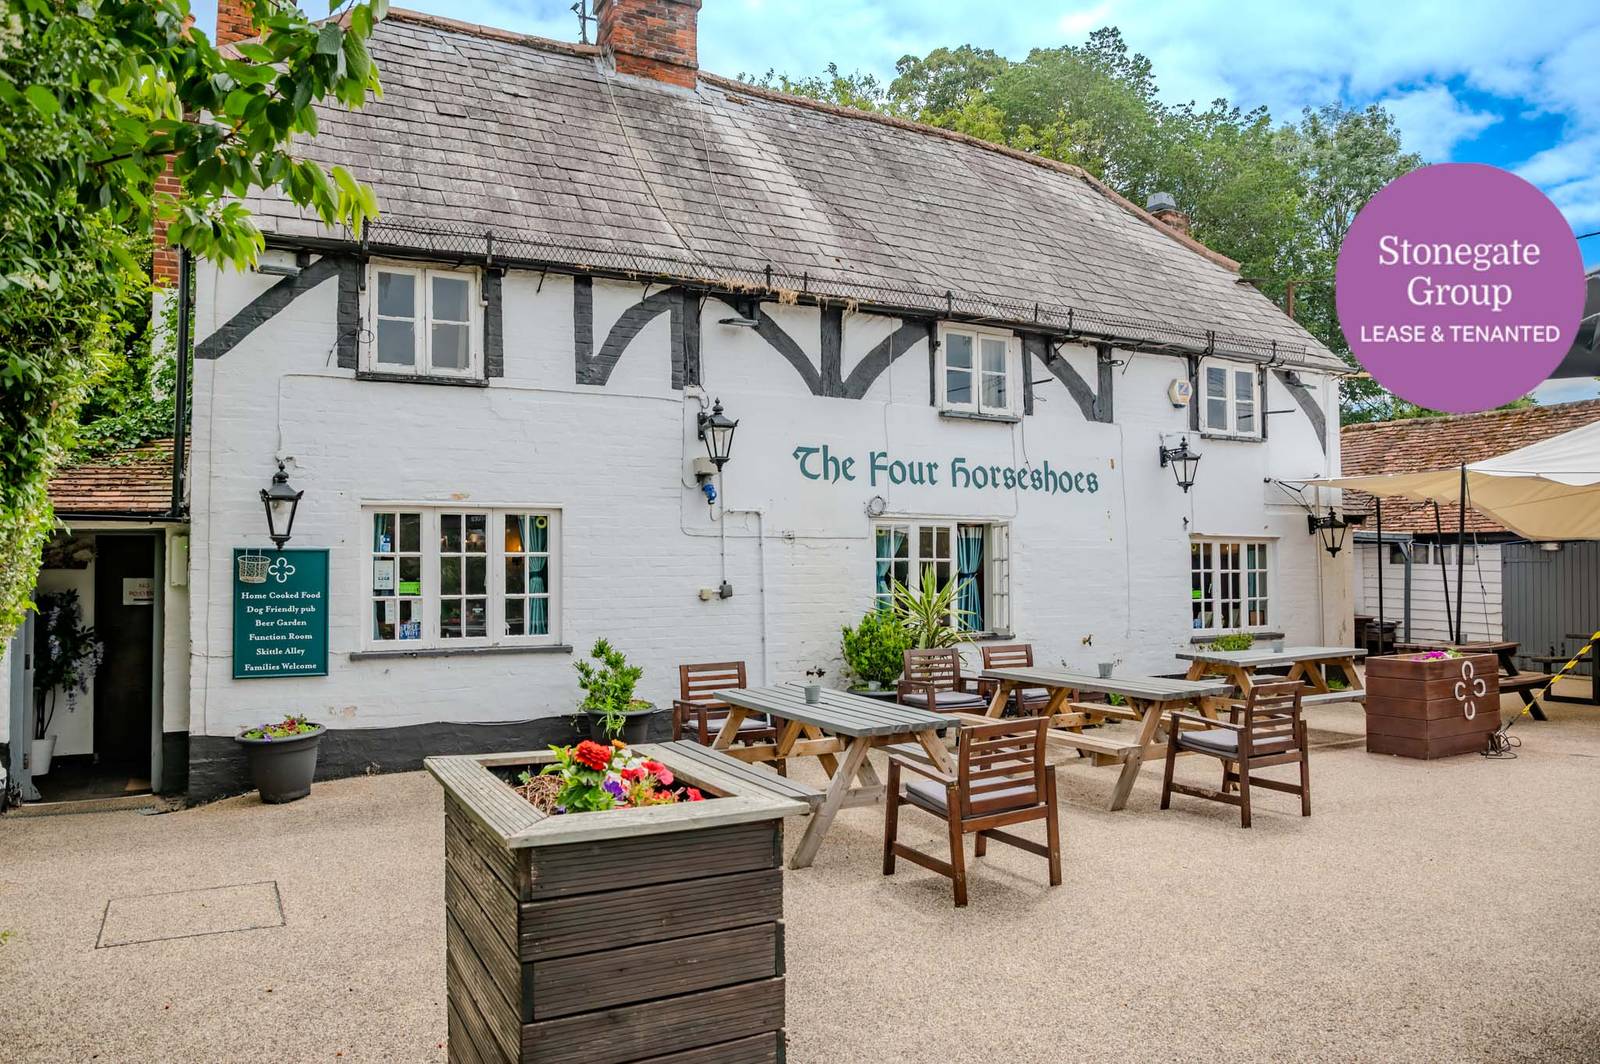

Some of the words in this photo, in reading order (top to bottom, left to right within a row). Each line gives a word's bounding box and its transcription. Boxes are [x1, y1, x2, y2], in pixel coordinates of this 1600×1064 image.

[792, 444, 856, 484] The
[869, 451, 939, 487] Four
[241, 591, 267, 600] Home
[269, 591, 299, 599] Cooked
[301, 591, 321, 599] Food
[246, 606, 264, 615] Dog
[265, 605, 299, 614] Friendly
[300, 605, 316, 614] pub
[255, 619, 275, 627] Beer
[249, 633, 287, 641] Function
[288, 632, 313, 640] Room
[256, 647, 283, 655] Skittle
[284, 647, 305, 656] Alley
[244, 663, 280, 671] Families
[281, 662, 317, 670] Welcome
